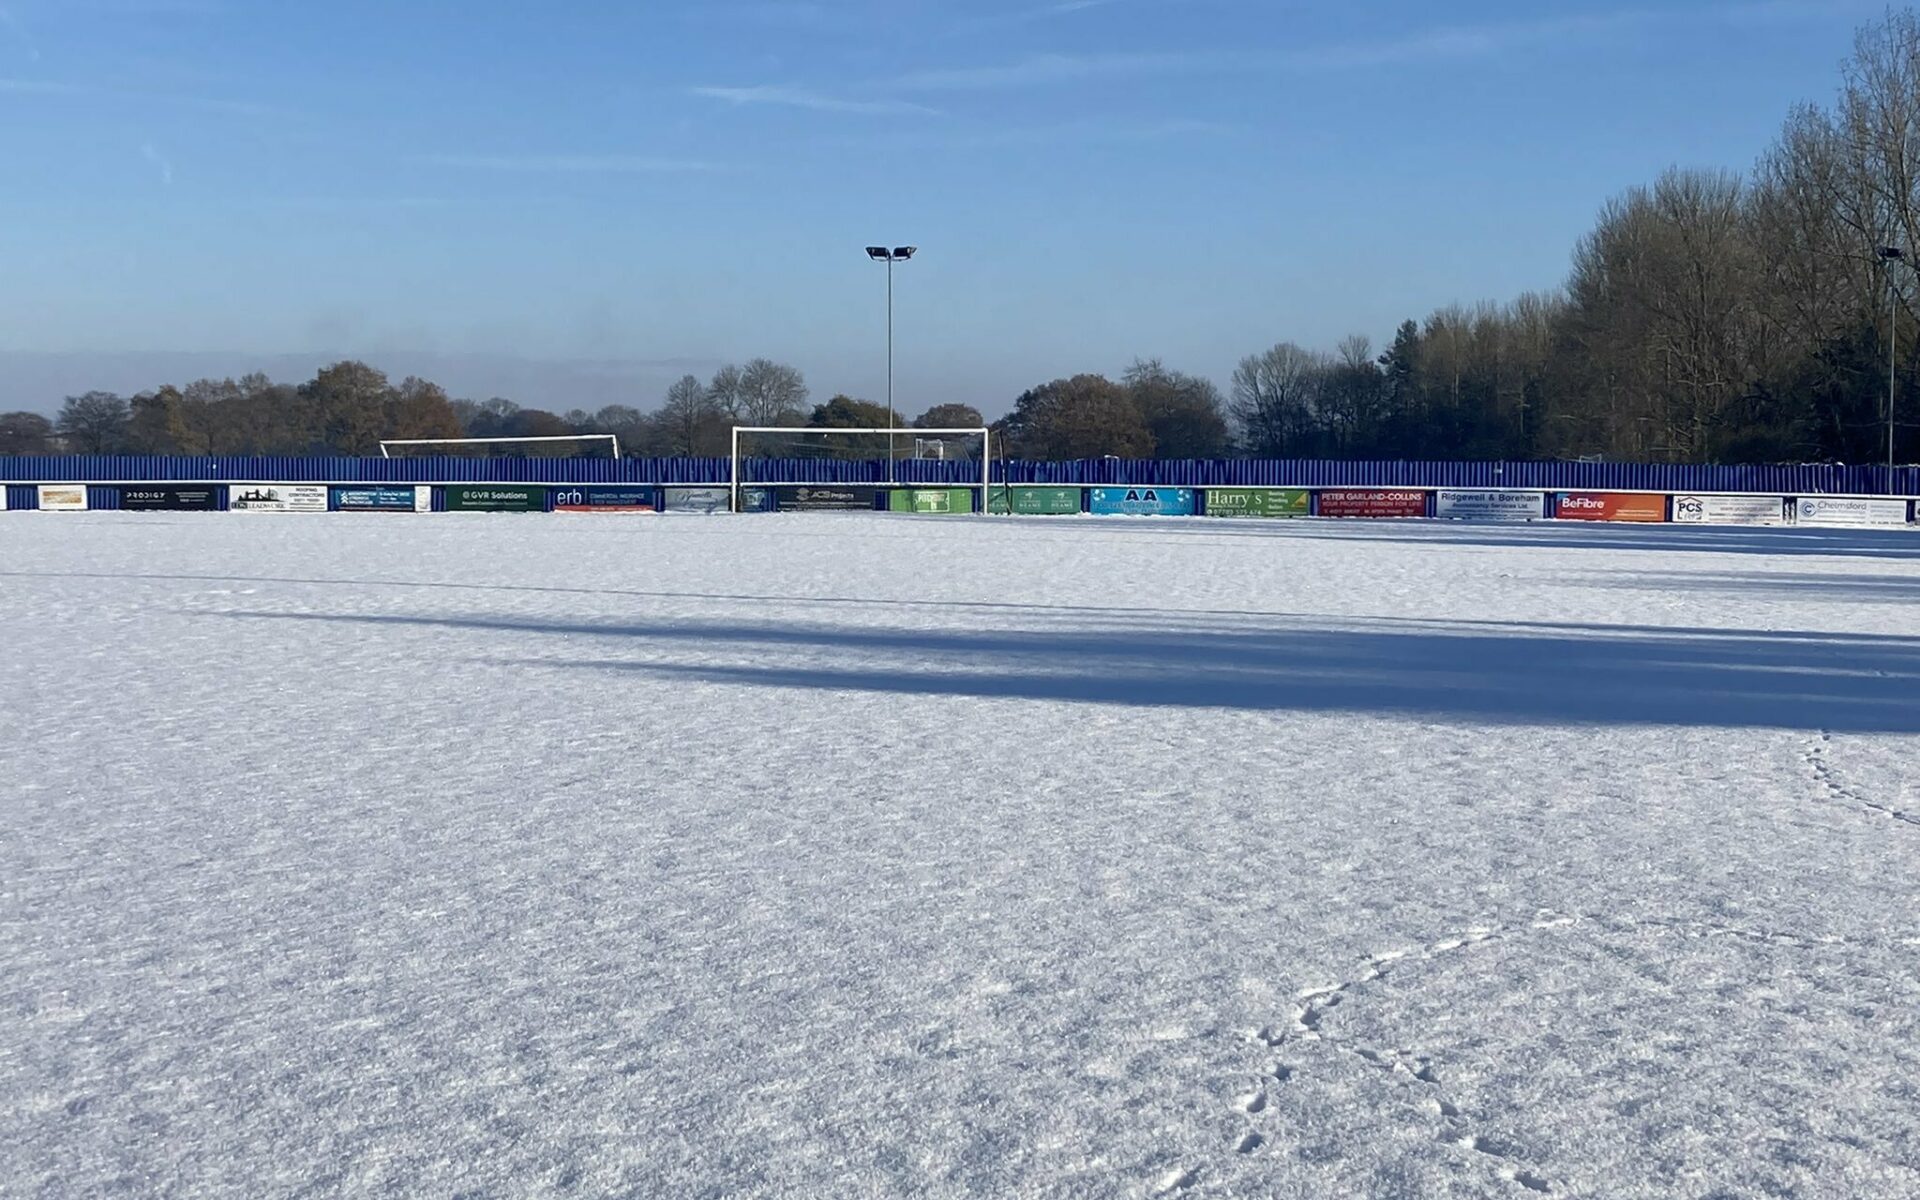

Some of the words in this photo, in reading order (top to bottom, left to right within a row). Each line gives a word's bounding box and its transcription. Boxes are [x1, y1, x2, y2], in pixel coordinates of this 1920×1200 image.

[470, 491, 490, 499] GVR
[491, 491, 528, 499] Solutions
[557, 488, 582, 505] erb
[1124, 489, 1158, 502] AA
[1441, 493, 1485, 502] Ridgewell
[1562, 498, 1605, 509] BeFibre
[1678, 503, 1703, 512] PCS
[1817, 501, 1867, 510] Chelmsford
